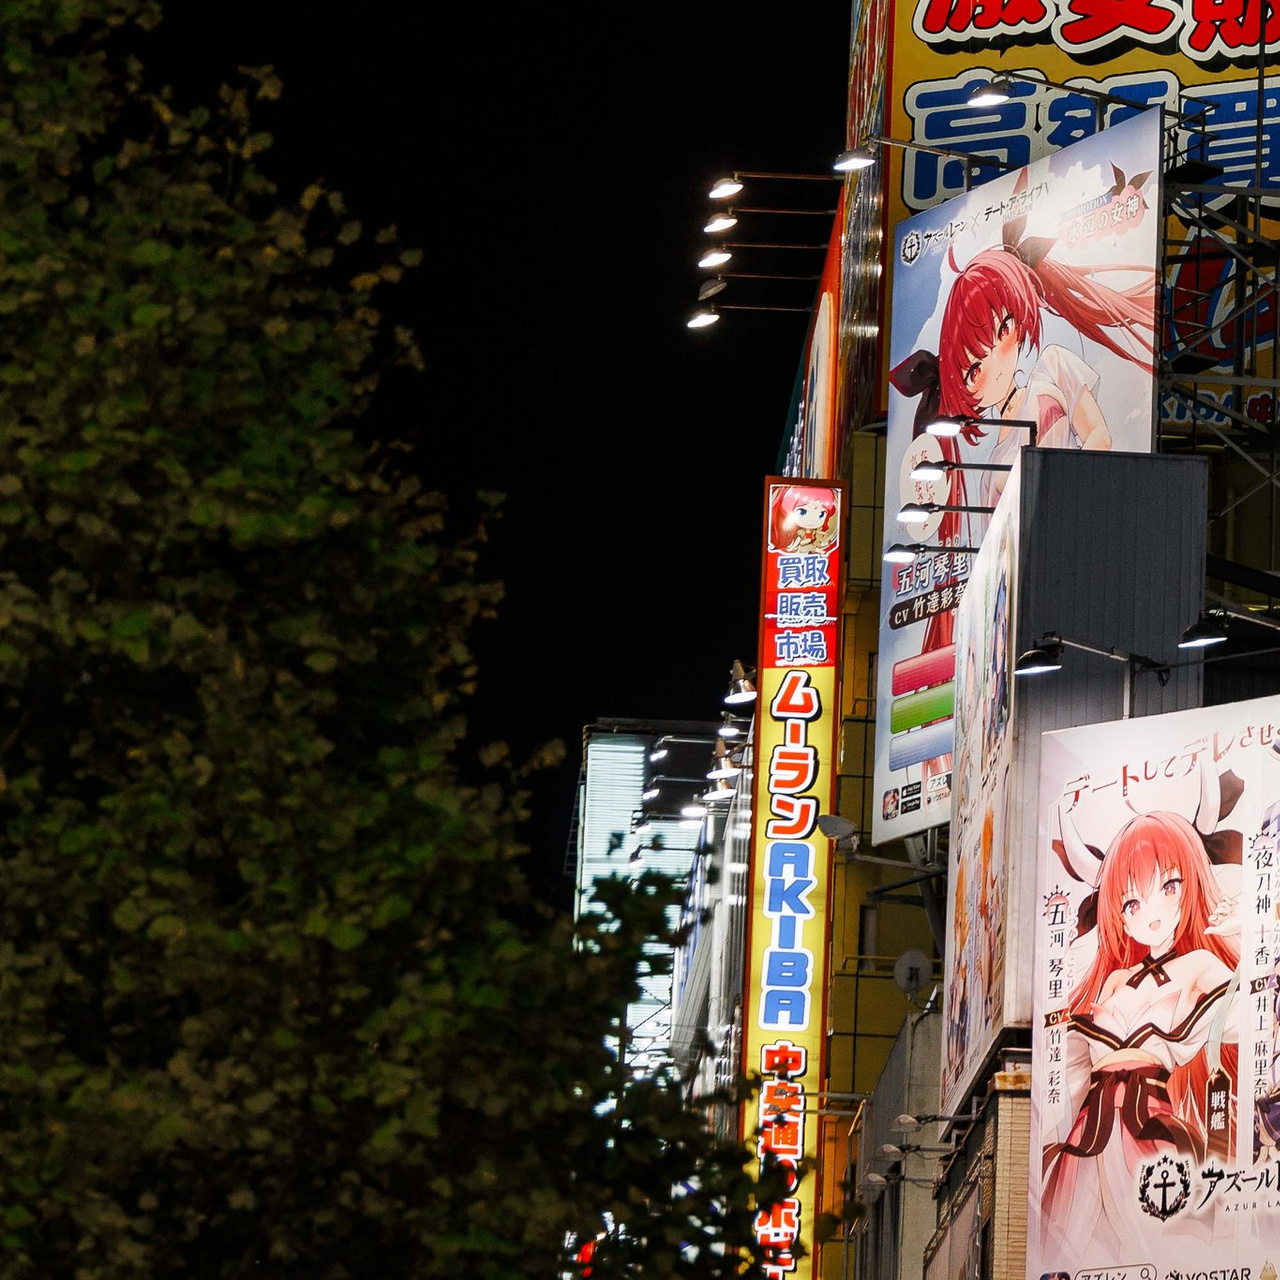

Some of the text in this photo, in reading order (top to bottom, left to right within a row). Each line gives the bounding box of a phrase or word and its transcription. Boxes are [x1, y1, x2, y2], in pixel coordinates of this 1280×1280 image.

[777, 554, 830, 586] 買取
[776, 592, 828, 625] 販売
[895, 609, 909, 625] CV
[775, 632, 828, 666] 市場
[1255, 978, 1273, 991] CV
[1049, 1012, 1064, 1025] CV
[1210, 1090, 1227, 1131] 戦艦
[1224, 1201, 1258, 1212] AZUR
